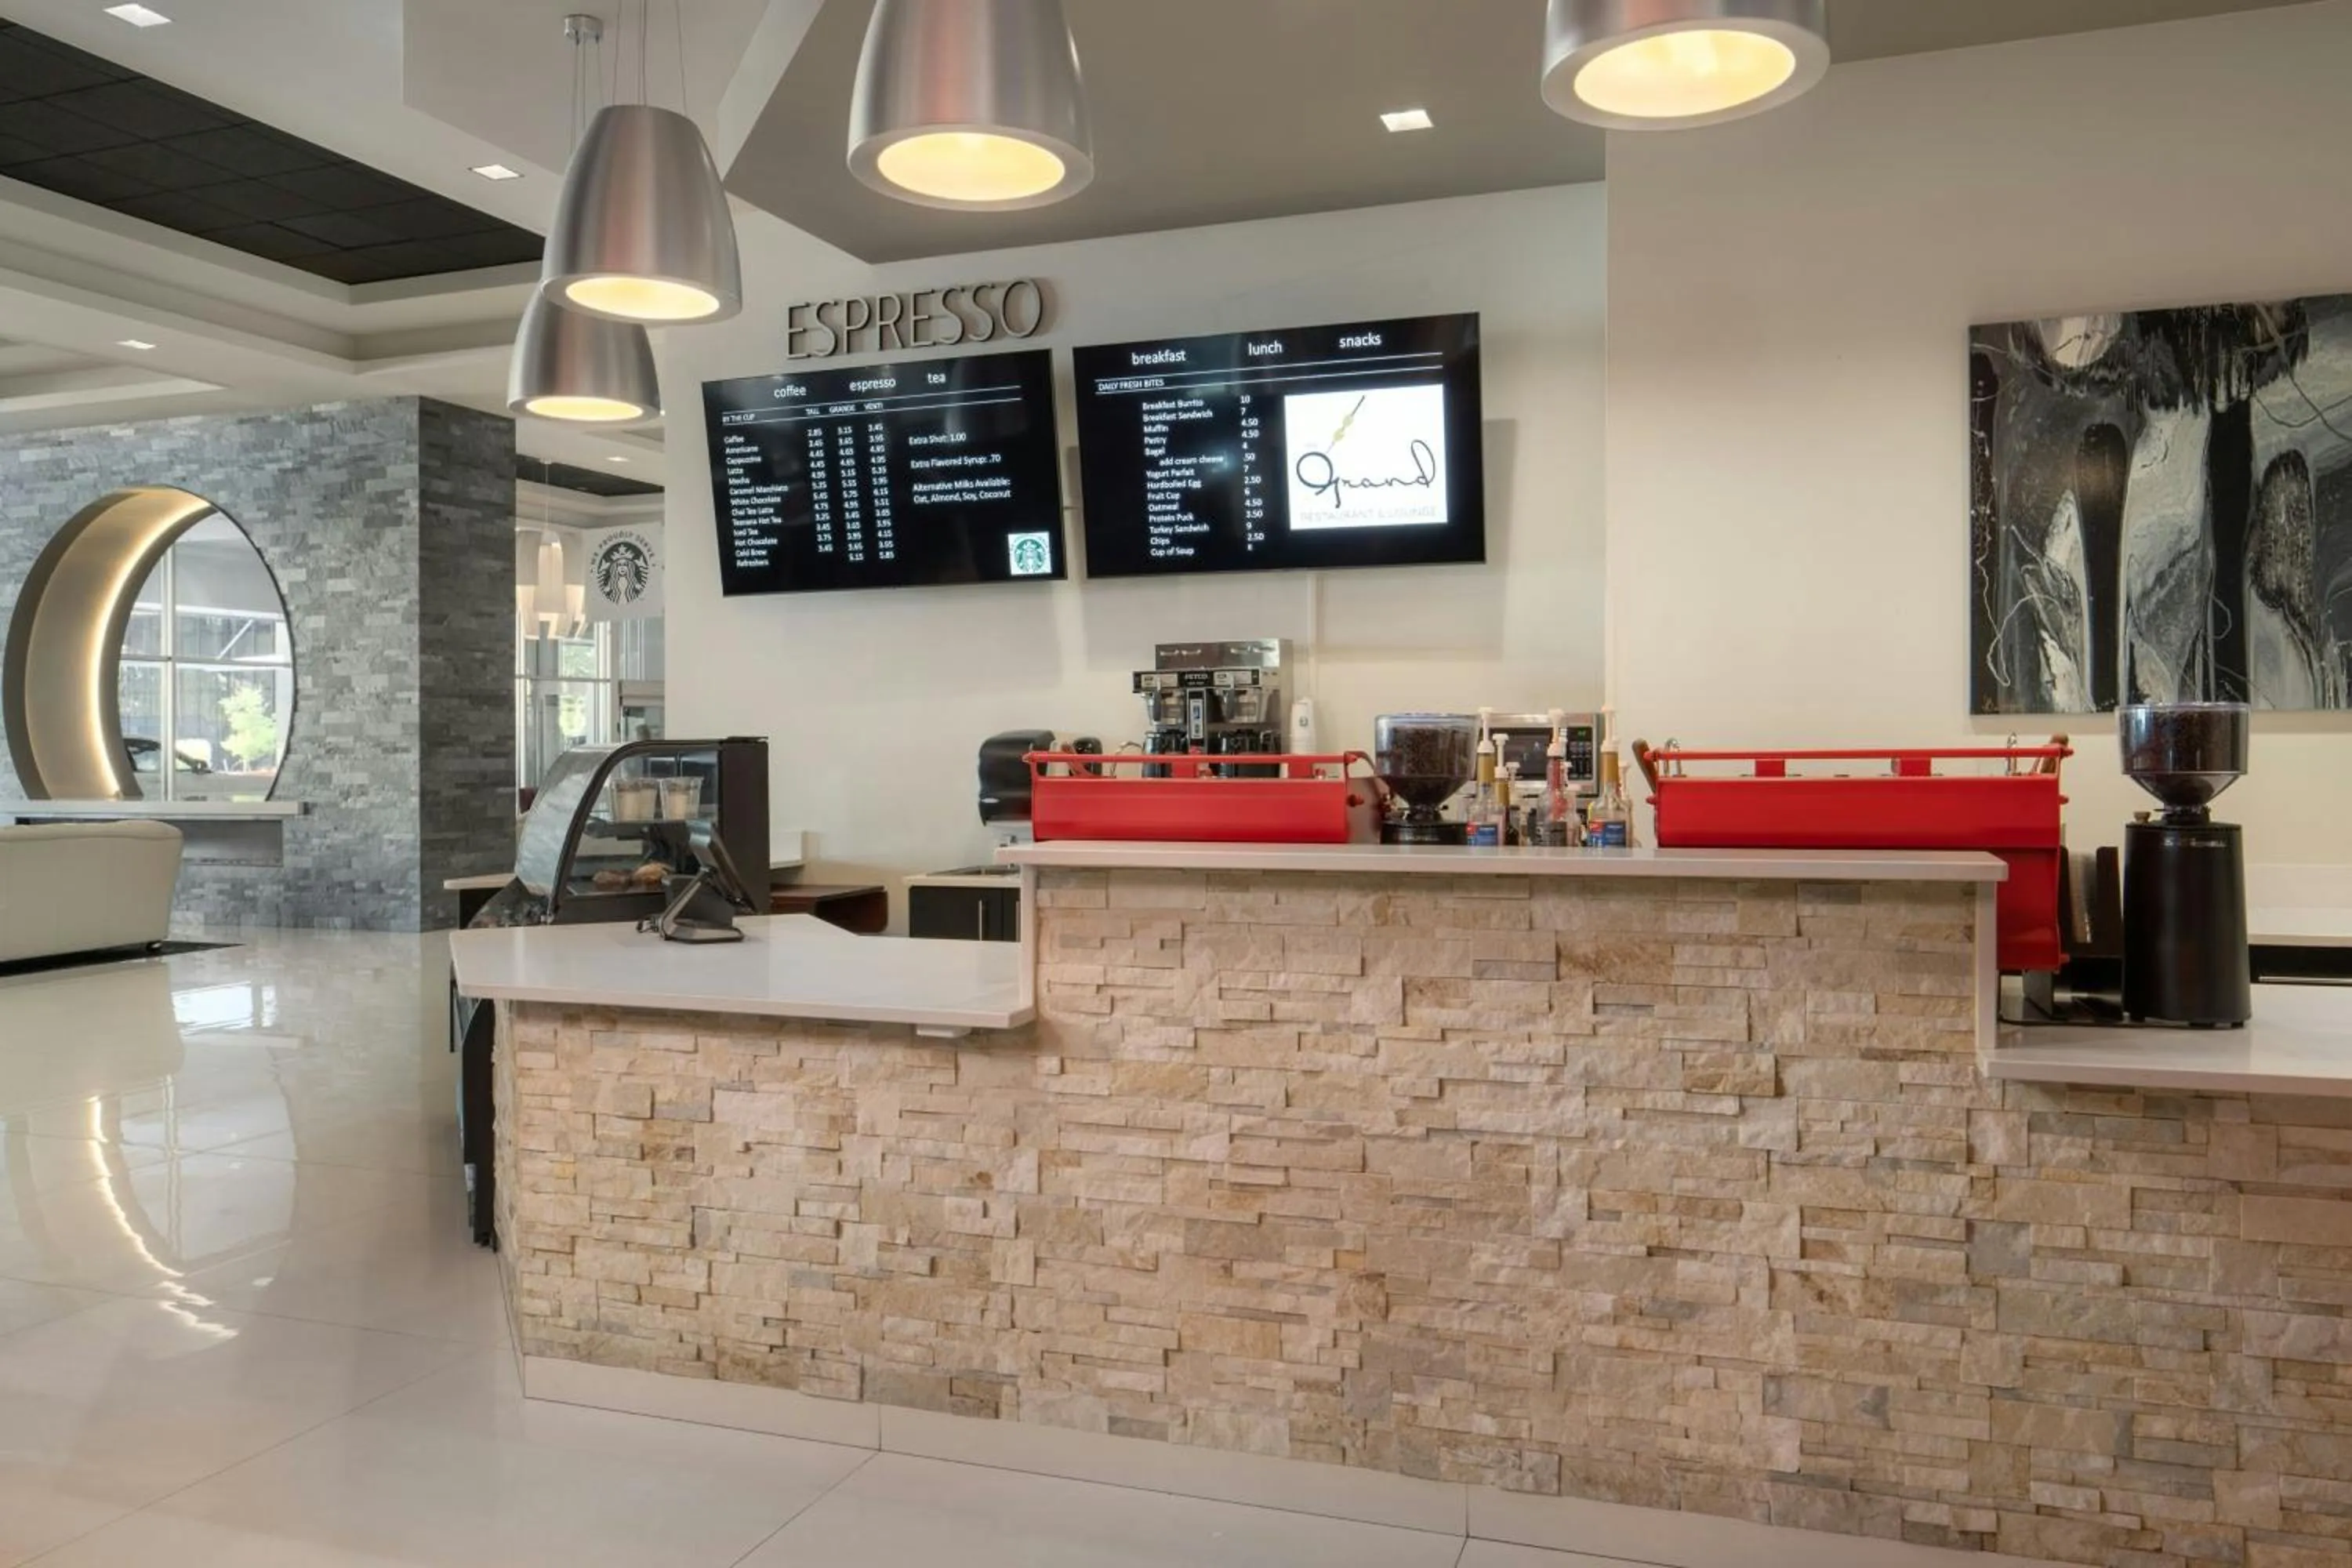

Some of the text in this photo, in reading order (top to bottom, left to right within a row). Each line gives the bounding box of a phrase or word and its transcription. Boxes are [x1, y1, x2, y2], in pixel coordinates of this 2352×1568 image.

[786, 278, 1044, 360] ESPRESSO
[1131, 333, 1381, 366] breakfast lunch snacks
[774, 372, 946, 400] coffee espresso tea
[1145, 379, 1164, 387] BITES
[1142, 395, 1250, 410] Breakfast Burrito 10
[1142, 413, 1177, 422] Breakfast
[1178, 409, 1213, 420] Sandwich
[1144, 418, 1258, 433] Muffin 4.50
[909, 433, 967, 445] Extra Shot: 1.00
[1145, 447, 1165, 456] Bagel
[911, 459, 930, 468] Extra
[931, 456, 961, 466] Flavored
[989, 454, 1001, 463] .70
[1146, 470, 1169, 479] Yogurt
[913, 477, 1010, 492] Alternative Milks Available:
[1147, 481, 1186, 489] Hardboiled
[931, 493, 961, 502] Almond,
[979, 490, 1011, 499] Coconut
[1149, 503, 1178, 511] Oatmeal
[1149, 525, 1173, 534] Turkey
[1175, 524, 1210, 532] Sandwich
[598, 531, 634, 549] PROUDLY
[748, 537, 778, 546] Chocolate
